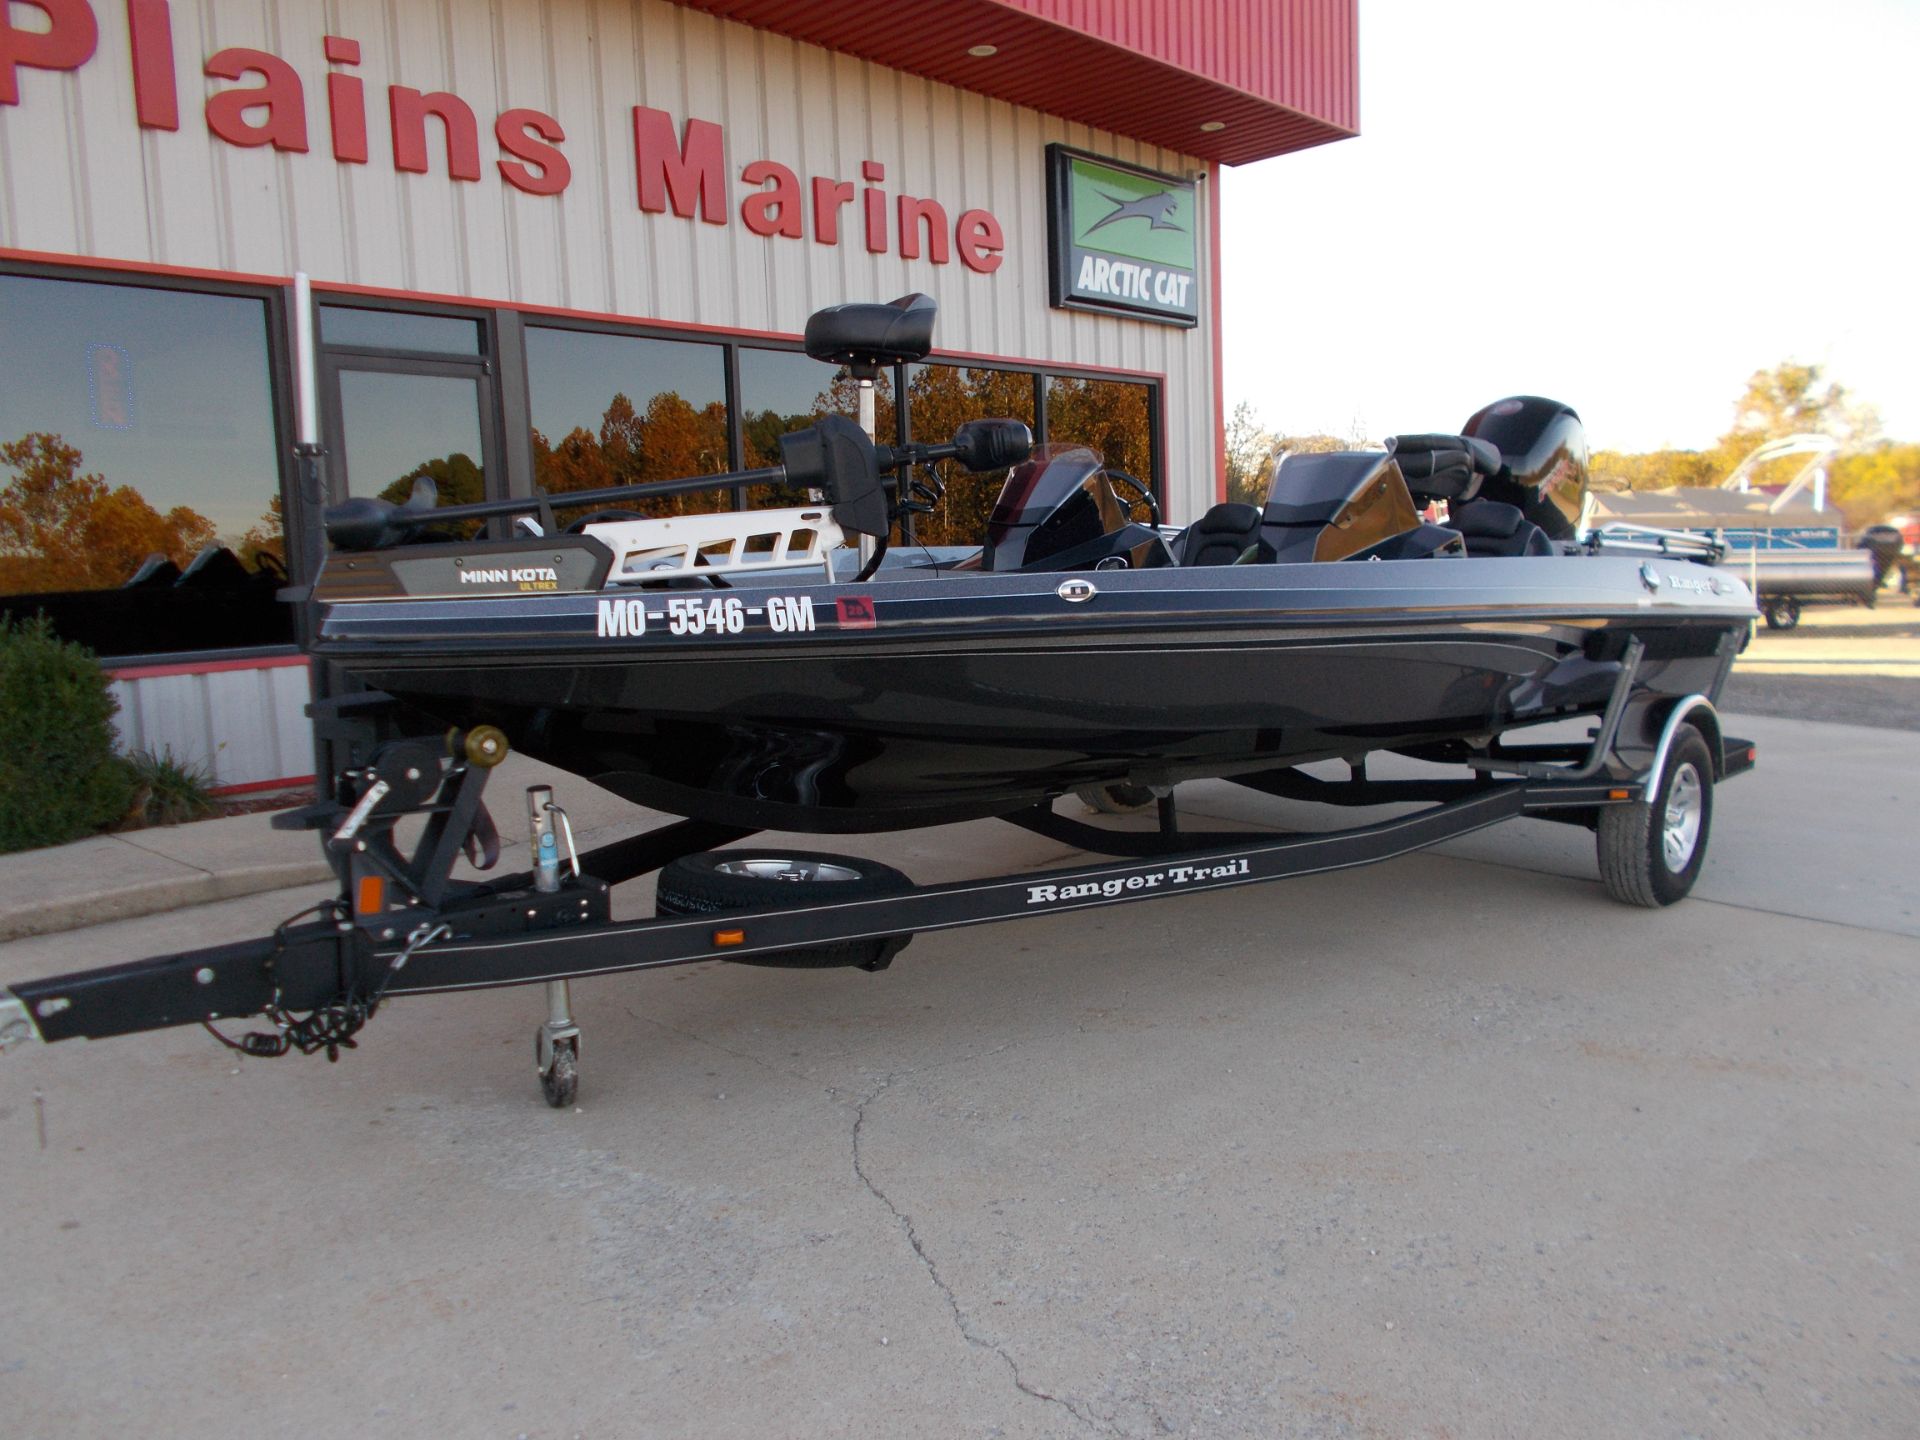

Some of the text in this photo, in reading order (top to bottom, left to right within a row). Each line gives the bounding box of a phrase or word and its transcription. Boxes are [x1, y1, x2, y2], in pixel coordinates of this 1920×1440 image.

[0, 0, 1004, 274] Plains Marine
[1077, 255, 1190, 308] ARCTIC CAT
[461, 567, 558, 584] MINN KOTA
[519, 581, 558, 591] ULTREX
[598, 596, 816, 638] MO-5546-GM
[1026, 858, 1251, 904] Ranger Trail
